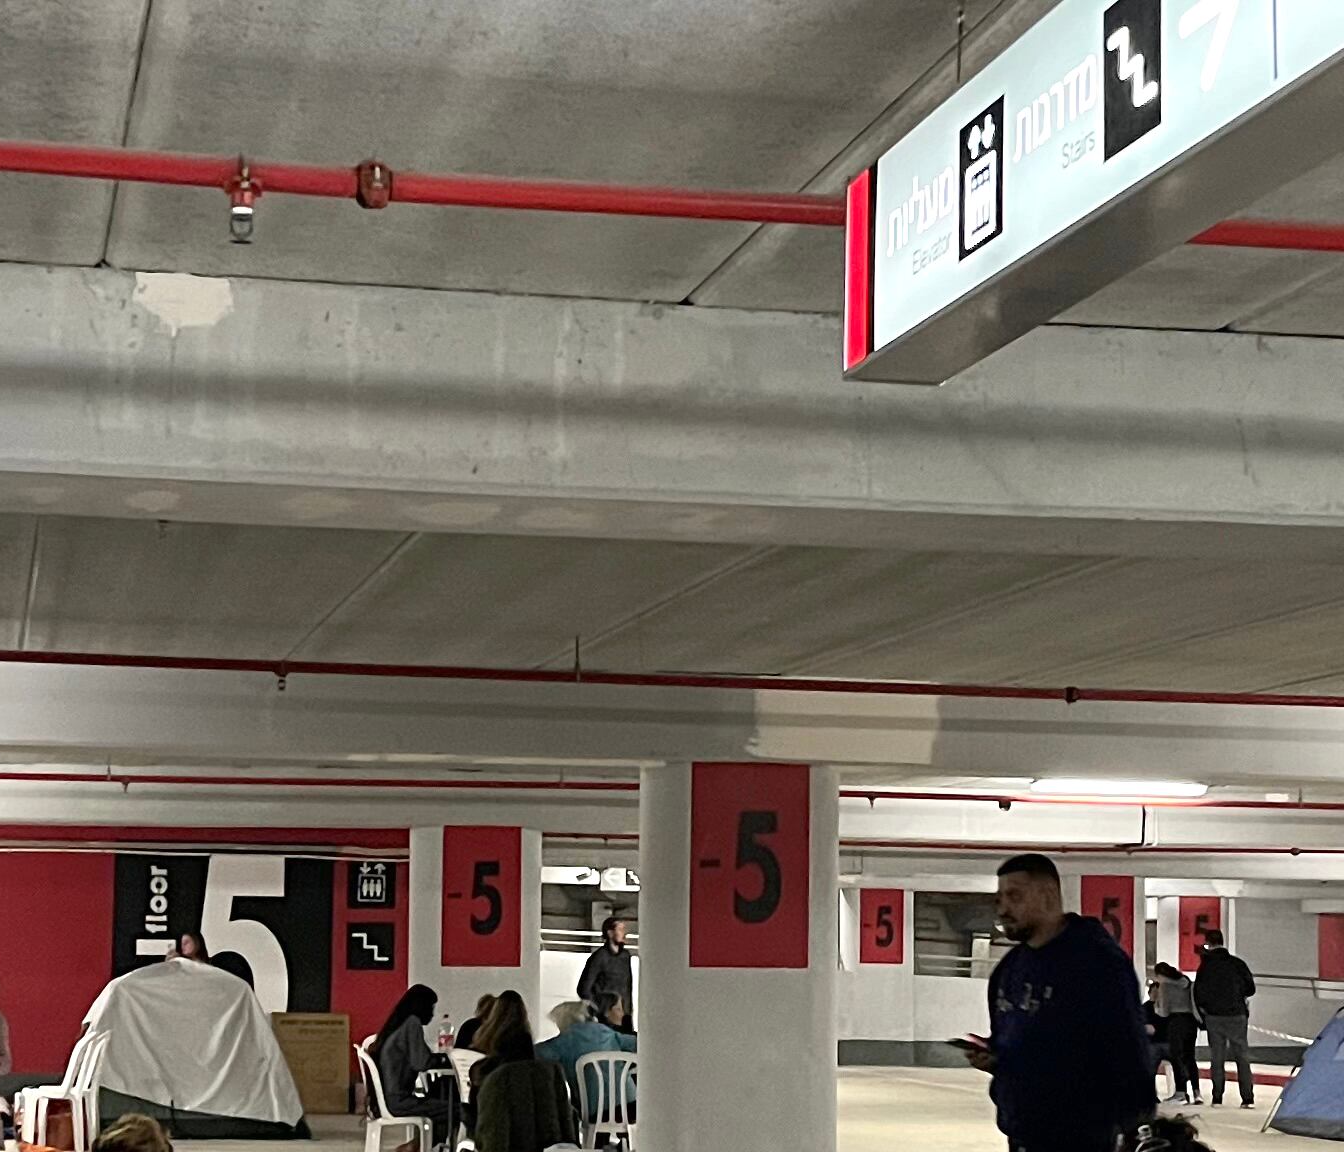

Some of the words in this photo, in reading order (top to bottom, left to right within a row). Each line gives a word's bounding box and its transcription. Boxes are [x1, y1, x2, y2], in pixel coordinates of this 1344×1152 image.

[1062, 131, 1095, 169] Stairs
[887, 166, 953, 257] מעליות
[145, 865, 168, 933] floor
[447, 861, 502, 935] -5
[700, 811, 781, 924] -5
[863, 905, 894, 947] -5
